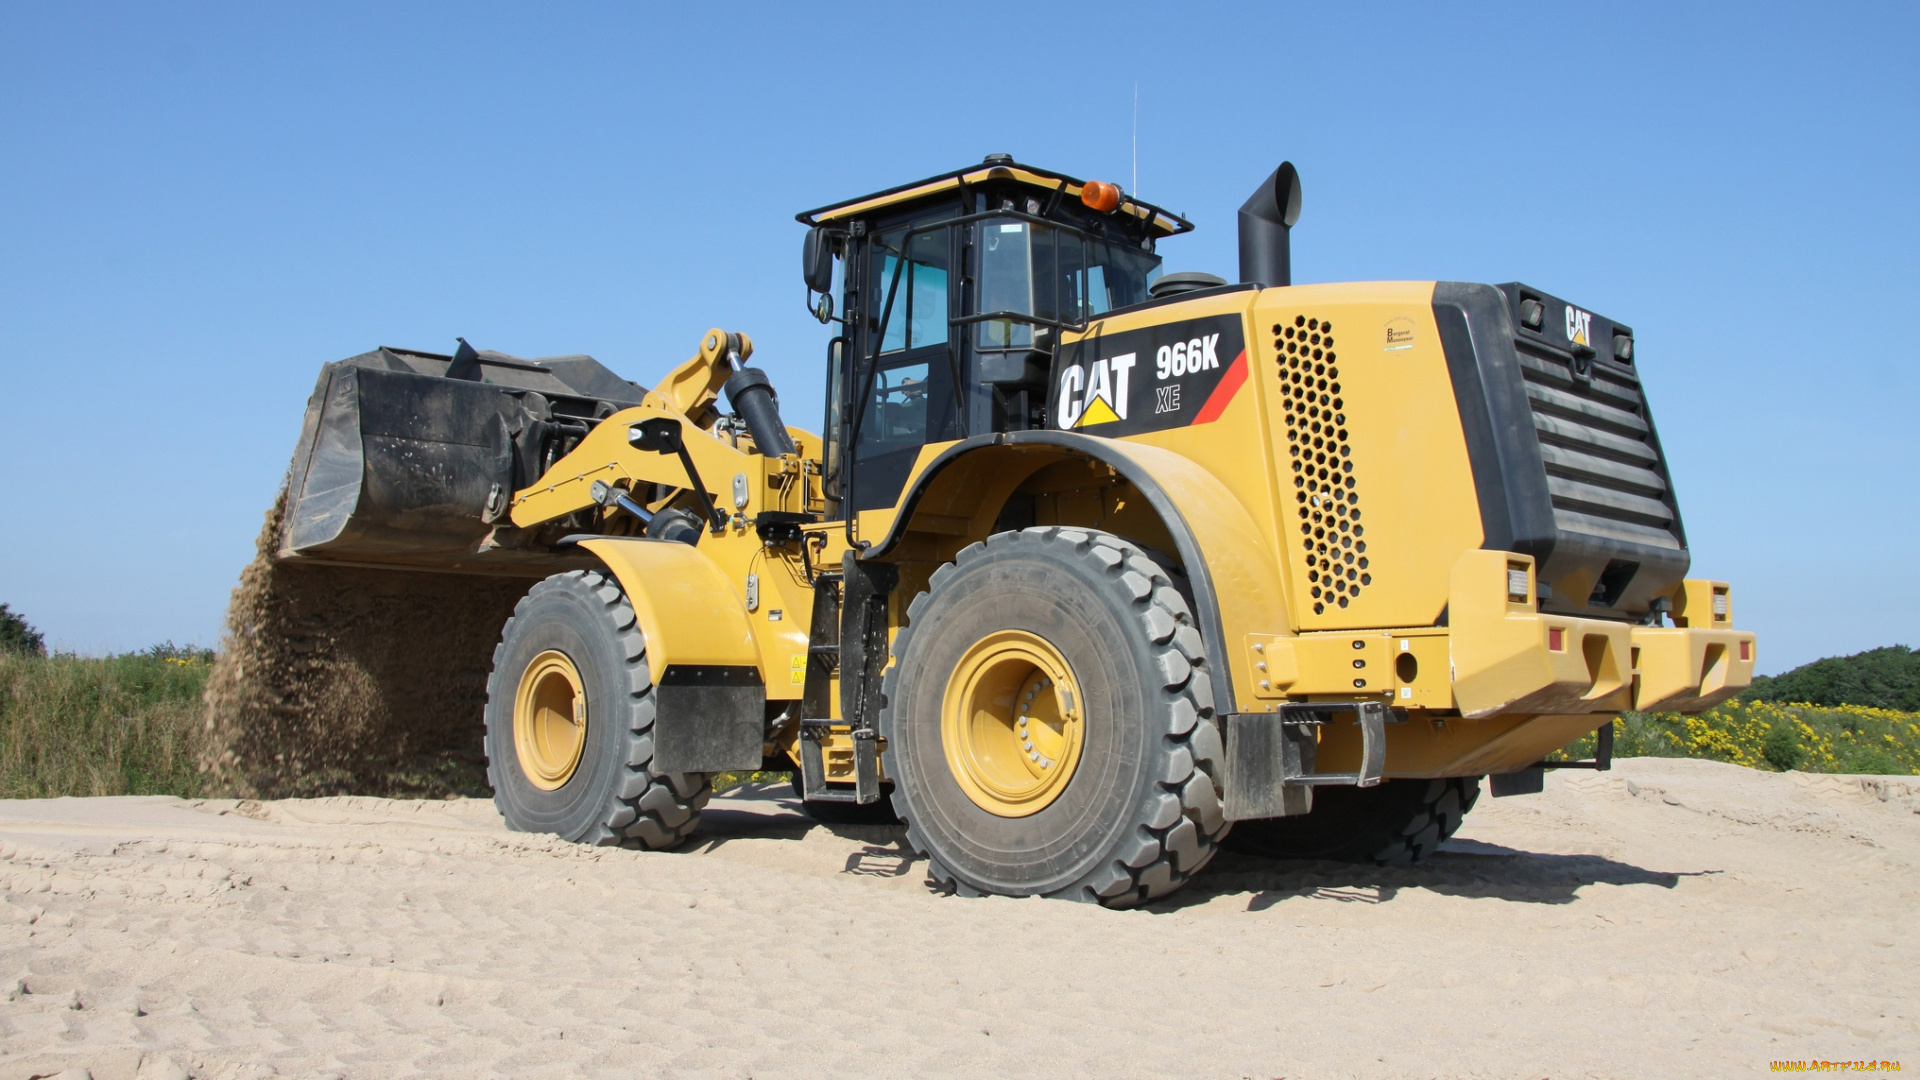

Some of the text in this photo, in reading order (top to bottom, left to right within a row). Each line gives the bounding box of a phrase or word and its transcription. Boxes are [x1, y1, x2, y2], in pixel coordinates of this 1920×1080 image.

[1565, 305, 1591, 347] CAT
[1156, 333, 1219, 380] 966K
[1058, 352, 1136, 430] CAT
[1155, 384, 1181, 414] XE
